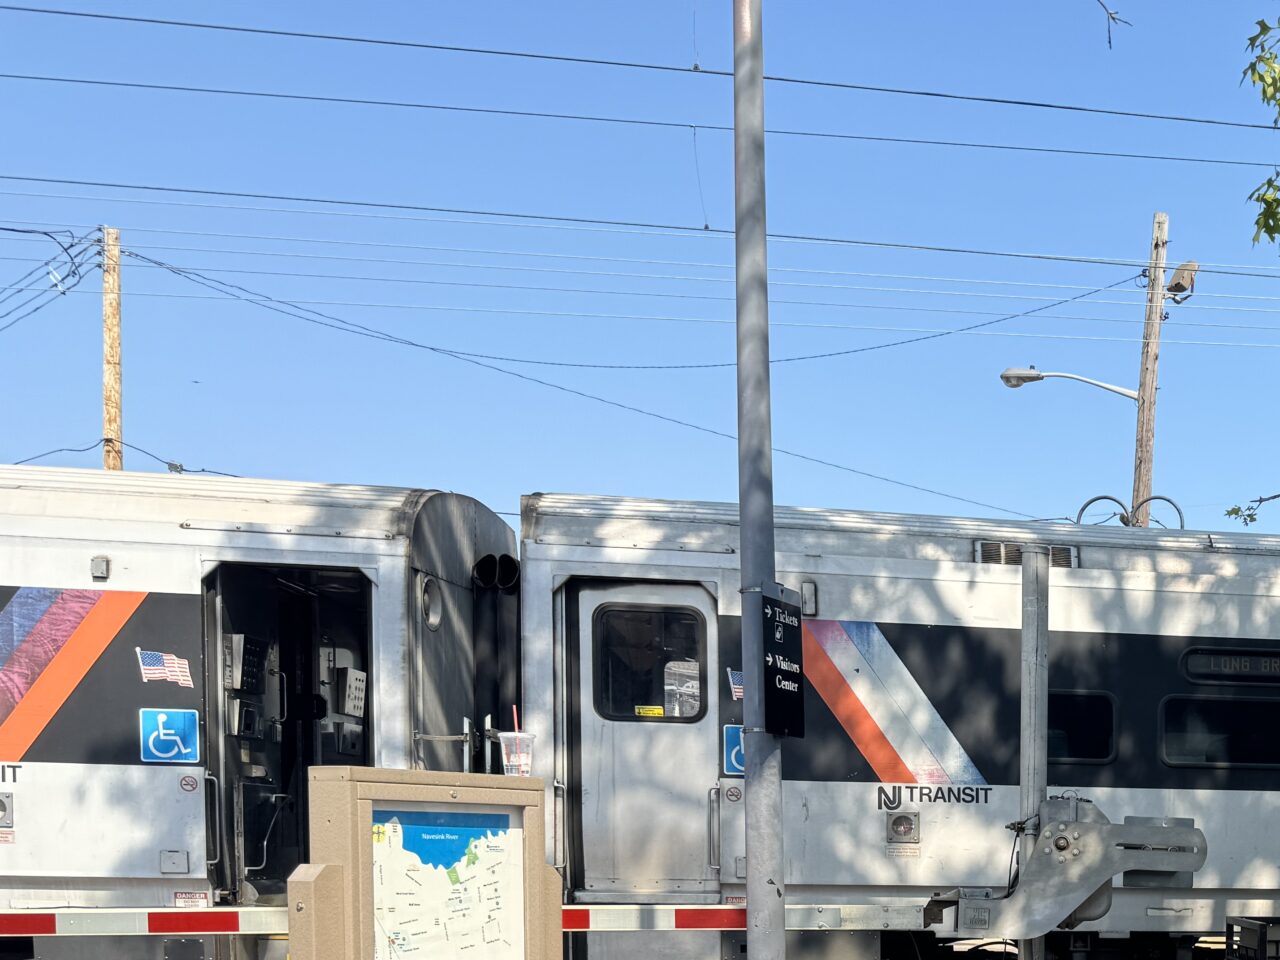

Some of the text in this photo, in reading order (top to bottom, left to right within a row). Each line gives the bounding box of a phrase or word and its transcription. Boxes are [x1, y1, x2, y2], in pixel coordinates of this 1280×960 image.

[774, 607, 798, 627] Tickets
[775, 654, 800, 673] Visitors
[1210, 655, 1250, 672] LONG
[775, 674, 799, 692] Center
[878, 786, 992, 811] NJ TRANSIT
